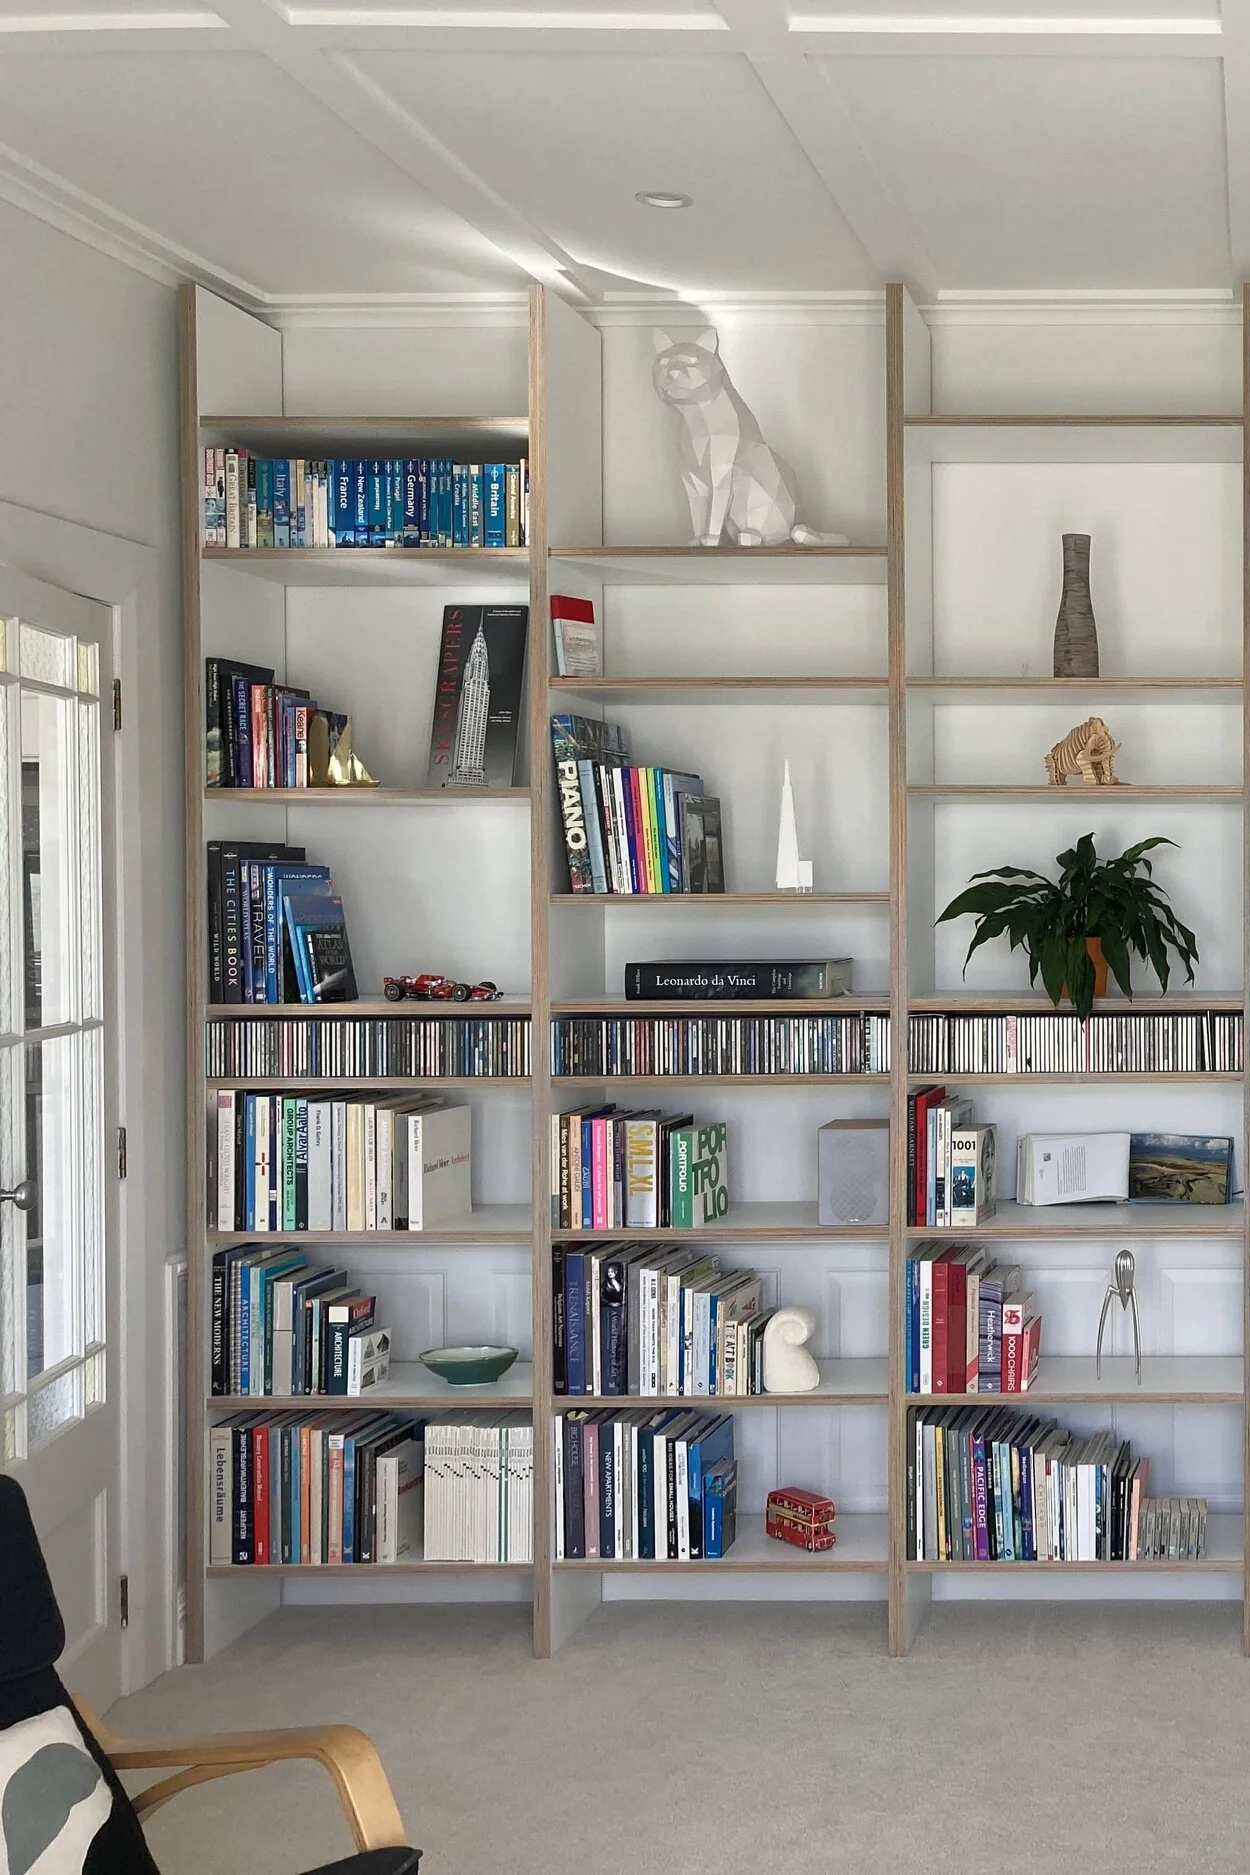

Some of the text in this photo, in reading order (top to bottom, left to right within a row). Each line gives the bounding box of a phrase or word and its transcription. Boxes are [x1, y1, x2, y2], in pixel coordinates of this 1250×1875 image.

[229, 474, 237, 534] GREAT BRITAIN
[275, 474, 286, 497] Italy
[340, 476, 349, 509] France
[406, 475, 416, 517] Germany
[490, 483, 499, 517] Britain
[434, 609, 463, 765] SKYSCRAPERS
[297, 710, 305, 738] Keane
[558, 761, 587, 850] PIANO
[226, 870, 237, 986] THE CITIES BOOK
[253, 902, 264, 964] TRAVEL
[267, 914, 274, 924] OF
[656, 975, 756, 986] Leonardo da Vinci
[679, 1141, 687, 1192] PORTFOLIO
[952, 1141, 976, 1150] 1001
[214, 1277, 222, 1365] THE NEW MODERNS
[570, 1288, 579, 1363] RENAISSANCE
[987, 1310, 995, 1362] Heatherwick
[334, 1332, 342, 1377] ARCHITECTURE
[725, 1341, 735, 1356] ART
[725, 1357, 735, 1381] BOOK
[570, 1427, 578, 1466] BIG HOUSE
[216, 1448, 226, 1523] Lebensräume
[977, 1467, 985, 1502] PACIFIC
